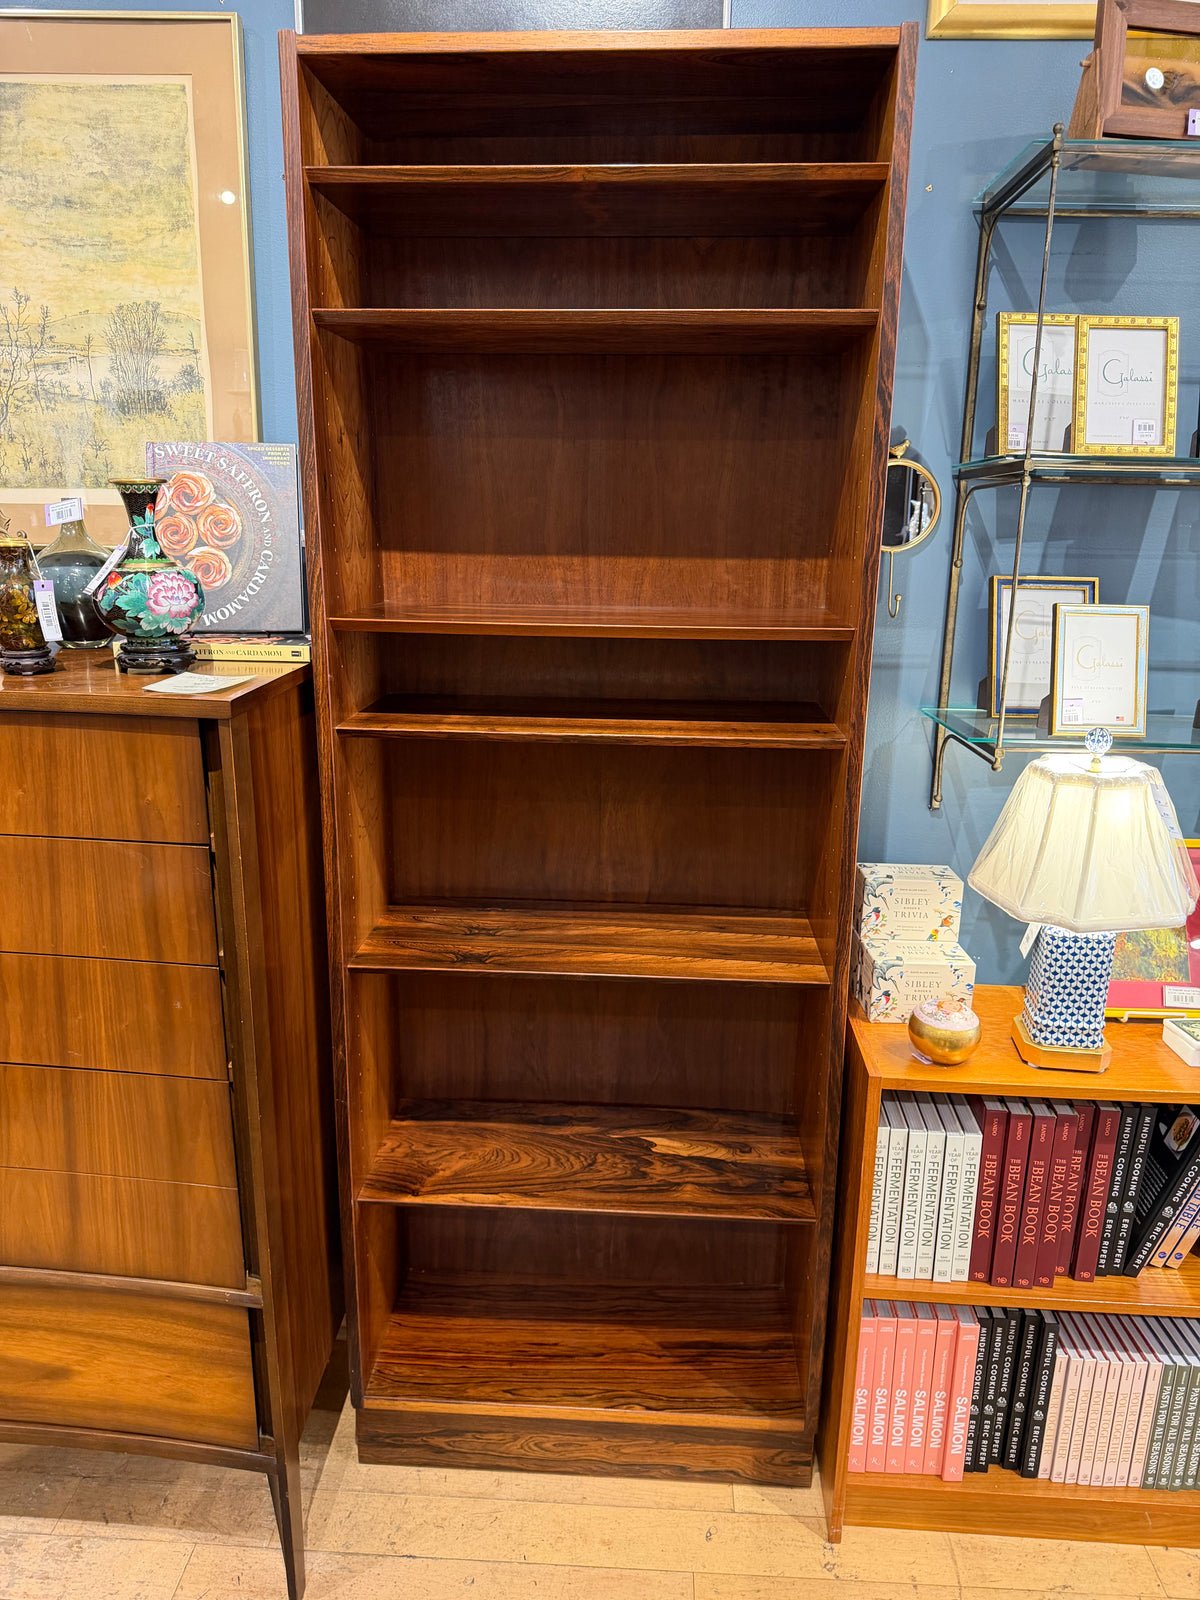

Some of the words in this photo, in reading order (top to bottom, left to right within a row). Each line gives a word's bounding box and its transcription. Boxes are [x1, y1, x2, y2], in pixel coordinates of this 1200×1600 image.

[1103, 358, 1153, 389] Galassi
[154, 443, 217, 464] SWEET
[216, 456, 273, 523] SAFFRON
[263, 526, 273, 546] AND
[202, 549, 274, 627] CARDAMOM
[1076, 643, 1123, 673] Galassi
[893, 910, 929, 919] TRIVIA
[894, 897, 930, 906] SIBLEY
[904, 980, 942, 989] SIBLEY
[1120, 1116, 1133, 1155] MINDFUL
[1137, 1116, 1151, 1154] MINDFUL
[982, 1160, 997, 1197] BEAN
[1006, 1165, 1021, 1202] BEAN
[1029, 1166, 1044, 1203] BEAN
[1051, 1165, 1066, 1202] BEAN
[1092, 1160, 1108, 1197] BEAN
[1111, 1157, 1125, 1197] COOKING
[1128, 1157, 1142, 1197] COOKING
[1172, 1165, 1198, 1203] COOKING
[869, 1156, 884, 1242] FERMENTATION
[885, 1158, 903, 1243] FERMENTATION
[904, 1161, 921, 1247] FERMENTATION
[921, 1161, 940, 1247] FERMENTATION
[940, 1164, 959, 1250] FERMENTATION
[957, 1163, 977, 1249] FERMENTATION
[1175, 1202, 1200, 1230] TABLE
[978, 1200, 993, 1238] BOOK
[1001, 1204, 1016, 1243] BOOK
[1023, 1206, 1039, 1245] BOOK
[1044, 1204, 1060, 1243] BOOK
[1085, 1200, 1102, 1238] BOOK
[1104, 1219, 1113, 1238] ERIC
[1120, 1218, 1129, 1238] ERIC
[1149, 1221, 1165, 1241] ERIC
[1098, 1240, 1109, 1269] RIPERT
[1113, 1240, 1125, 1268] RIPERT
[1132, 1241, 1152, 1269] RIPERT
[977, 1327, 987, 1361] MINDFUL
[993, 1327, 1003, 1362] MINDFUL
[1006, 1320, 1016, 1354] MINDFUL
[1024, 1324, 1035, 1359] MINDFUL
[1044, 1332, 1055, 1367] MINDFUL
[973, 1364, 983, 1400] COOKING
[988, 1364, 998, 1400] COOKING
[1001, 1357, 1011, 1392] COOKING
[1019, 1362, 1029, 1397] COOKING
[1038, 1370, 1049, 1405] COOKING
[1051, 1385, 1060, 1409] POUR
[1066, 1389, 1077, 1412] POUR
[1078, 1390, 1090, 1414] POUR
[1092, 1391, 1102, 1415] POUR
[1105, 1392, 1116, 1417] POUR
[1116, 1393, 1128, 1417] POUR
[1129, 1392, 1141, 1417] POUR
[1143, 1393, 1155, 1418] POUR
[1160, 1386, 1172, 1409] PASTA
[1173, 1387, 1186, 1409] PASTA
[1188, 1388, 1200, 1410] PASTA
[852, 1388, 868, 1446] SALMON
[872, 1388, 888, 1445] SALMON
[891, 1389, 907, 1447] SALMON
[910, 1390, 926, 1448] SALMON
[929, 1390, 946, 1449] SALMON
[951, 1396, 968, 1455] SALMON
[968, 1421, 976, 1437] ERIC
[982, 1421, 990, 1437] ERIC
[995, 1412, 1003, 1429] ERIC
[1013, 1418, 1021, 1434] ERIC
[1154, 1426, 1164, 1440] ALL
[1156, 1410, 1167, 1425] FOR
[1170, 1411, 1181, 1426] FOR
[1184, 1412, 1196, 1427] FOR
[992, 1432, 1000, 1457] RIPERT
[1009, 1437, 1018, 1462] RIPERT
[1032, 1426, 1040, 1442] ERIC
[1044, 1414, 1058, 1455] TOGETHER
[1058, 1415, 1071, 1459] TOGETHER
[1071, 1416, 1084, 1460] TOGETHER
[1084, 1418, 1098, 1461] TOGETHER
[1096, 1419, 1110, 1462] TOGETHER
[1109, 1420, 1123, 1463] TOGETHER
[1121, 1419, 1135, 1463] TOGETHER
[1134, 1420, 1150, 1463] TOGETHER
[1167, 1427, 1178, 1441] ALL
[1182, 1429, 1192, 1442] ALL
[965, 1440, 973, 1465] RIPERT
[979, 1440, 988, 1465] RIPERT
[1028, 1446, 1037, 1471] RIPERT
[1148, 1442, 1161, 1474] SEASONS
[1161, 1443, 1175, 1475] SEASONS
[1175, 1444, 1189, 1476] SEASONS
